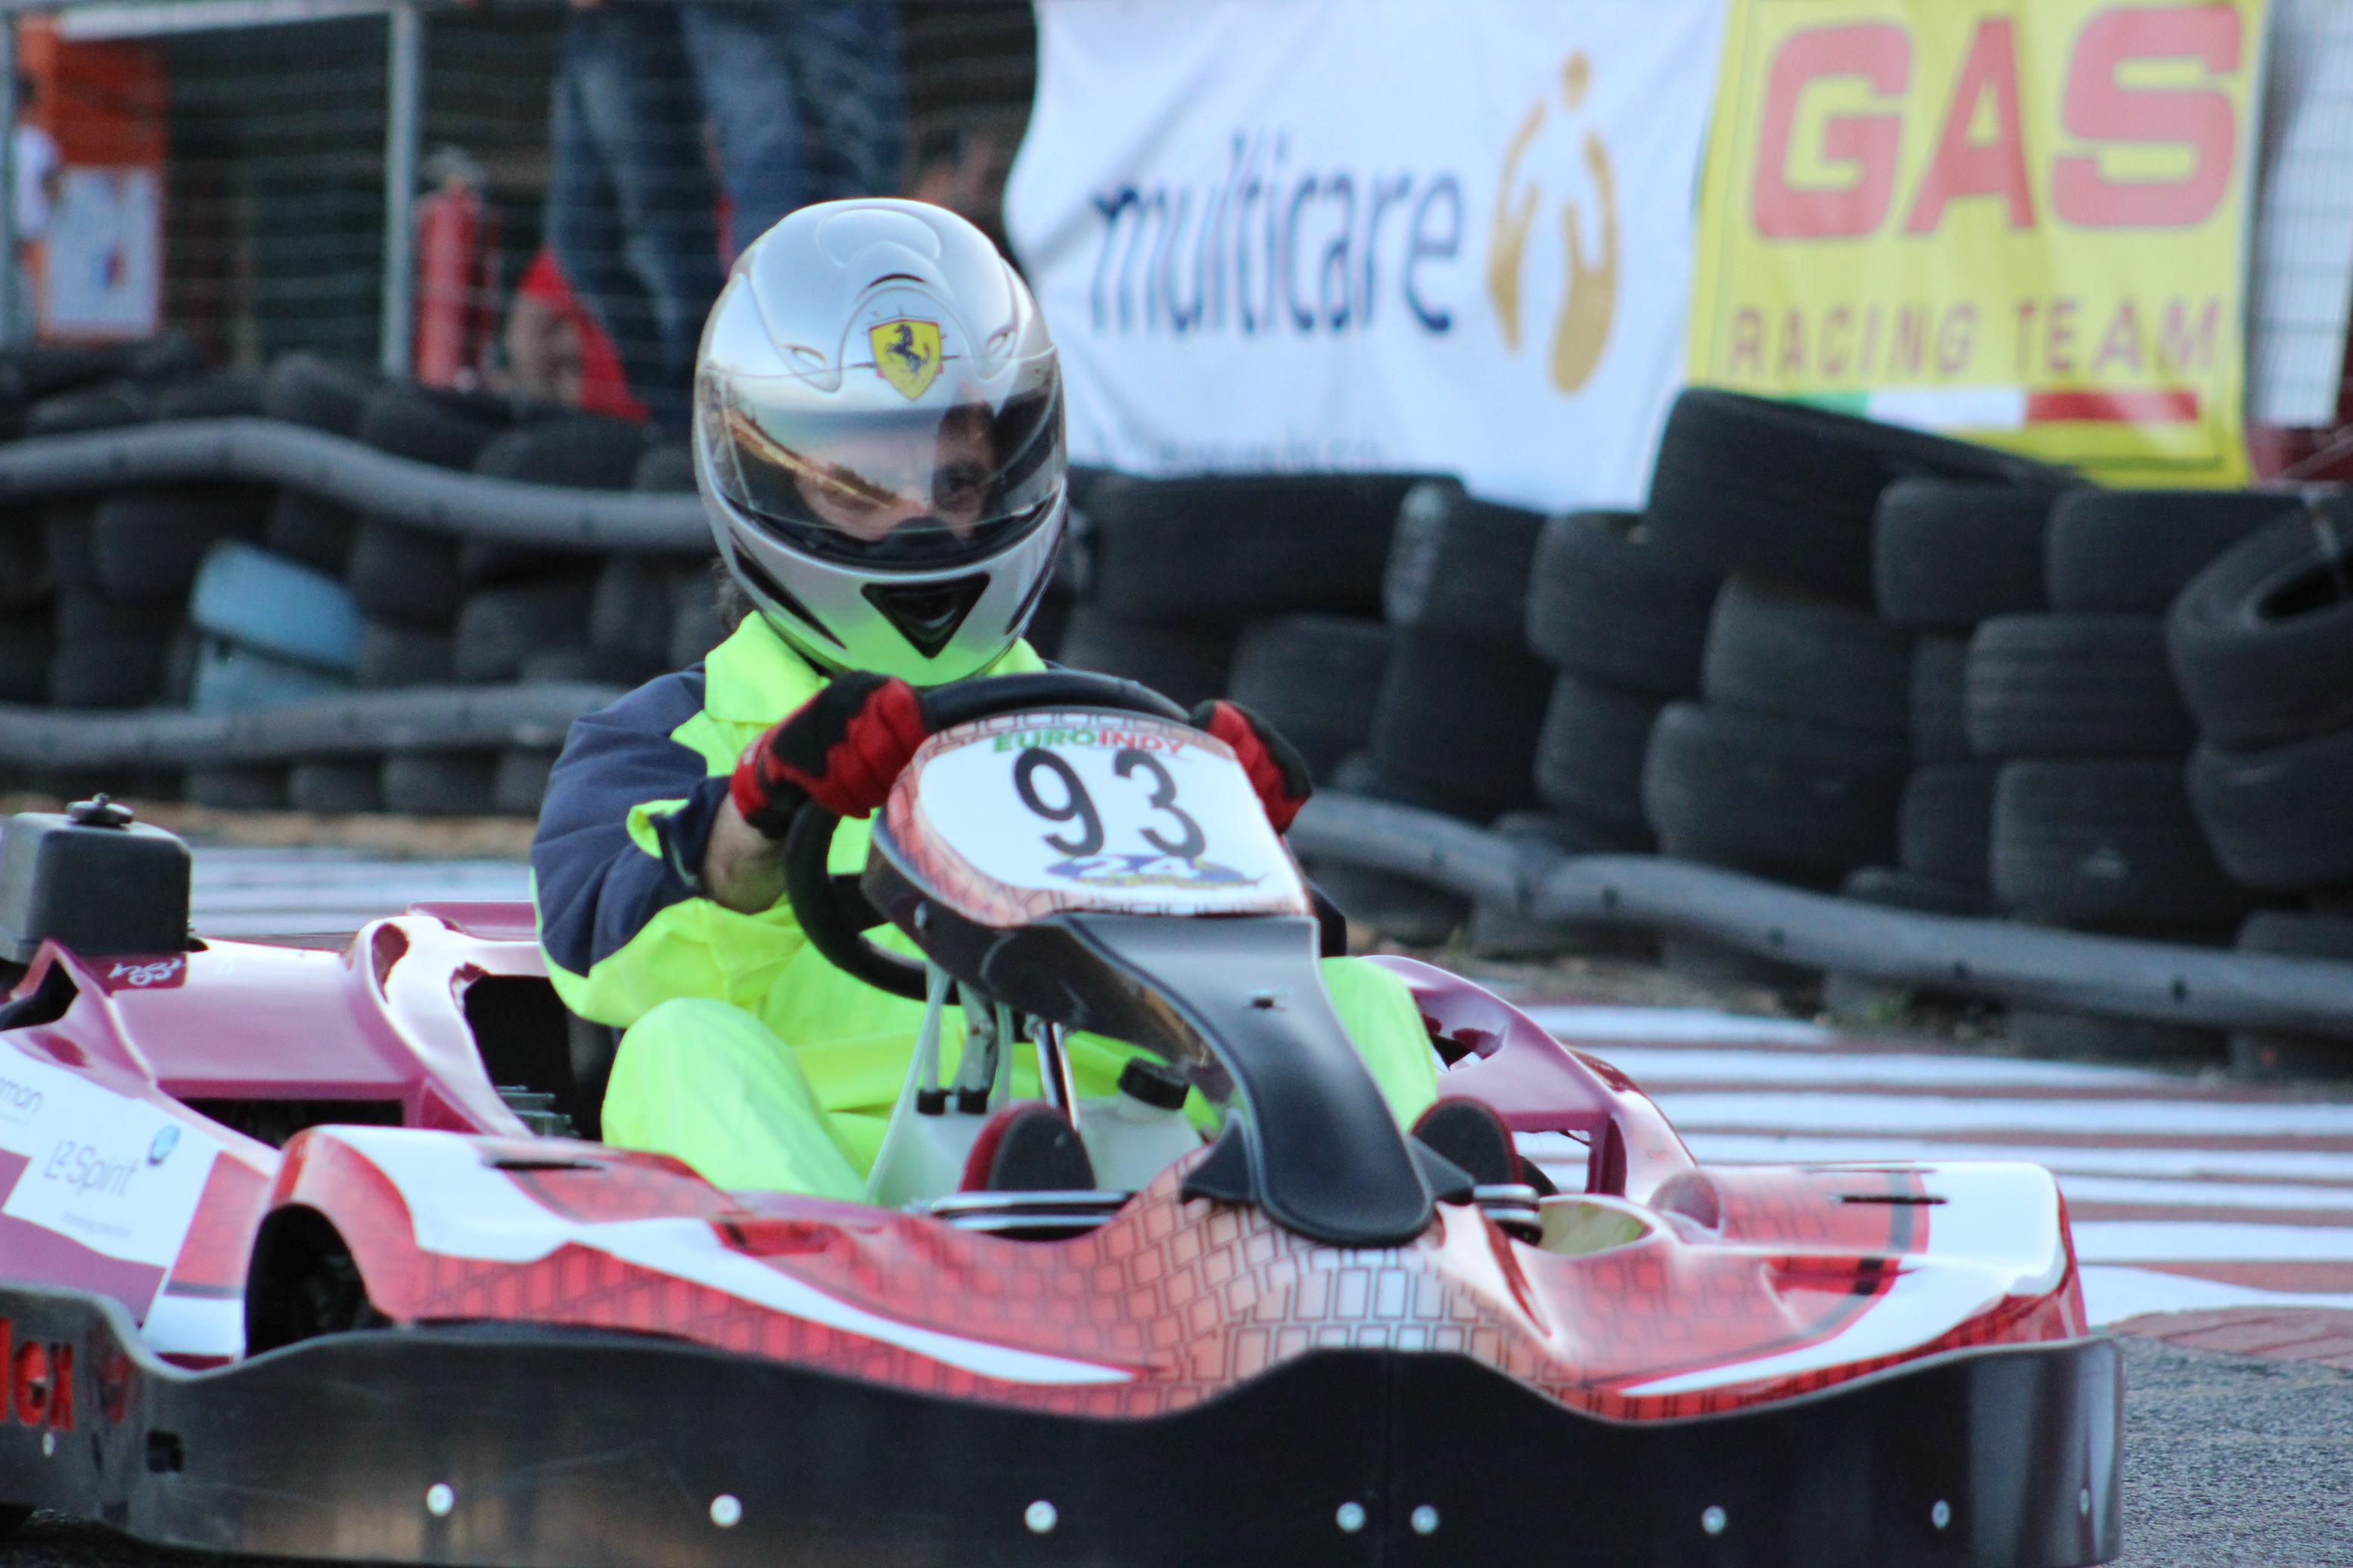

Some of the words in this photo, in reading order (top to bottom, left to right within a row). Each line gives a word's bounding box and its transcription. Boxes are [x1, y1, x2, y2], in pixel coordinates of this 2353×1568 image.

[1752, 3, 2243, 241] GAS
[1091, 130, 1463, 333] multicare
[1730, 301, 1976, 375] RACING
[2016, 298, 2221, 375] TEAM
[993, 728, 1186, 756] EUROINDY
[1014, 747, 1206, 859] 93
